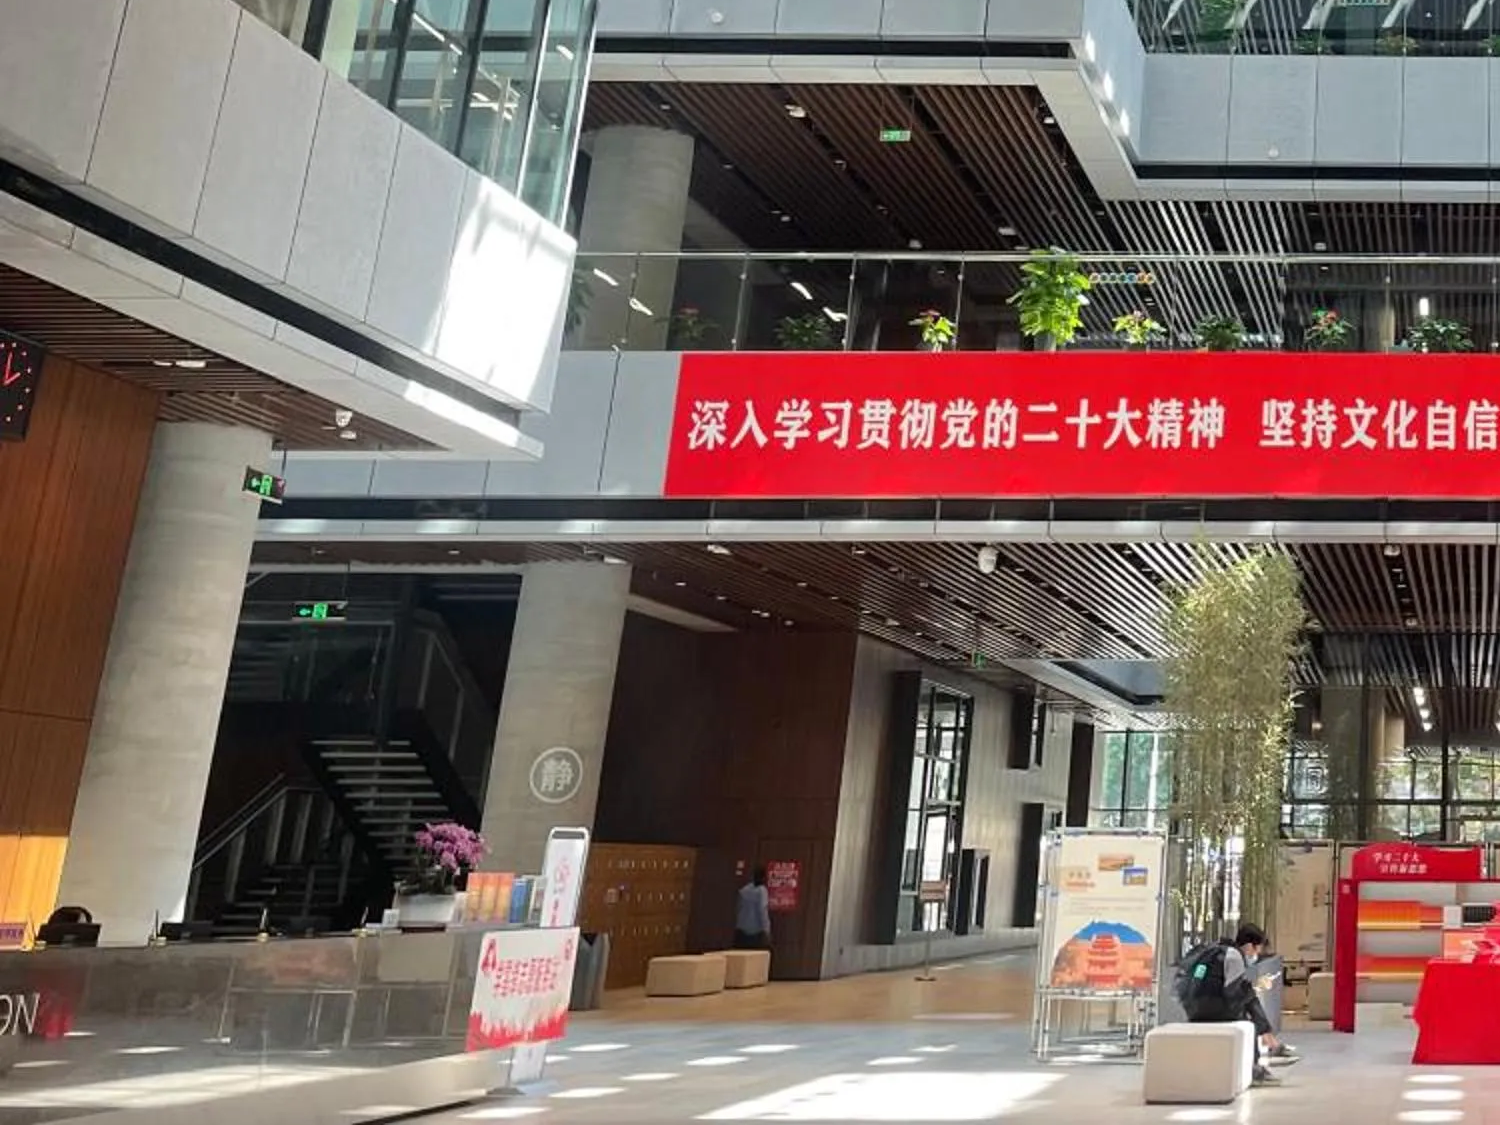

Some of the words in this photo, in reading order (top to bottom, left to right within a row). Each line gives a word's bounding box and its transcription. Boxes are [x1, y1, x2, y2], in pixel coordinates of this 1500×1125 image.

[687, 397, 1226, 450] 深入学习贯彻党的二十大精神
[541, 757, 575, 793] 静
